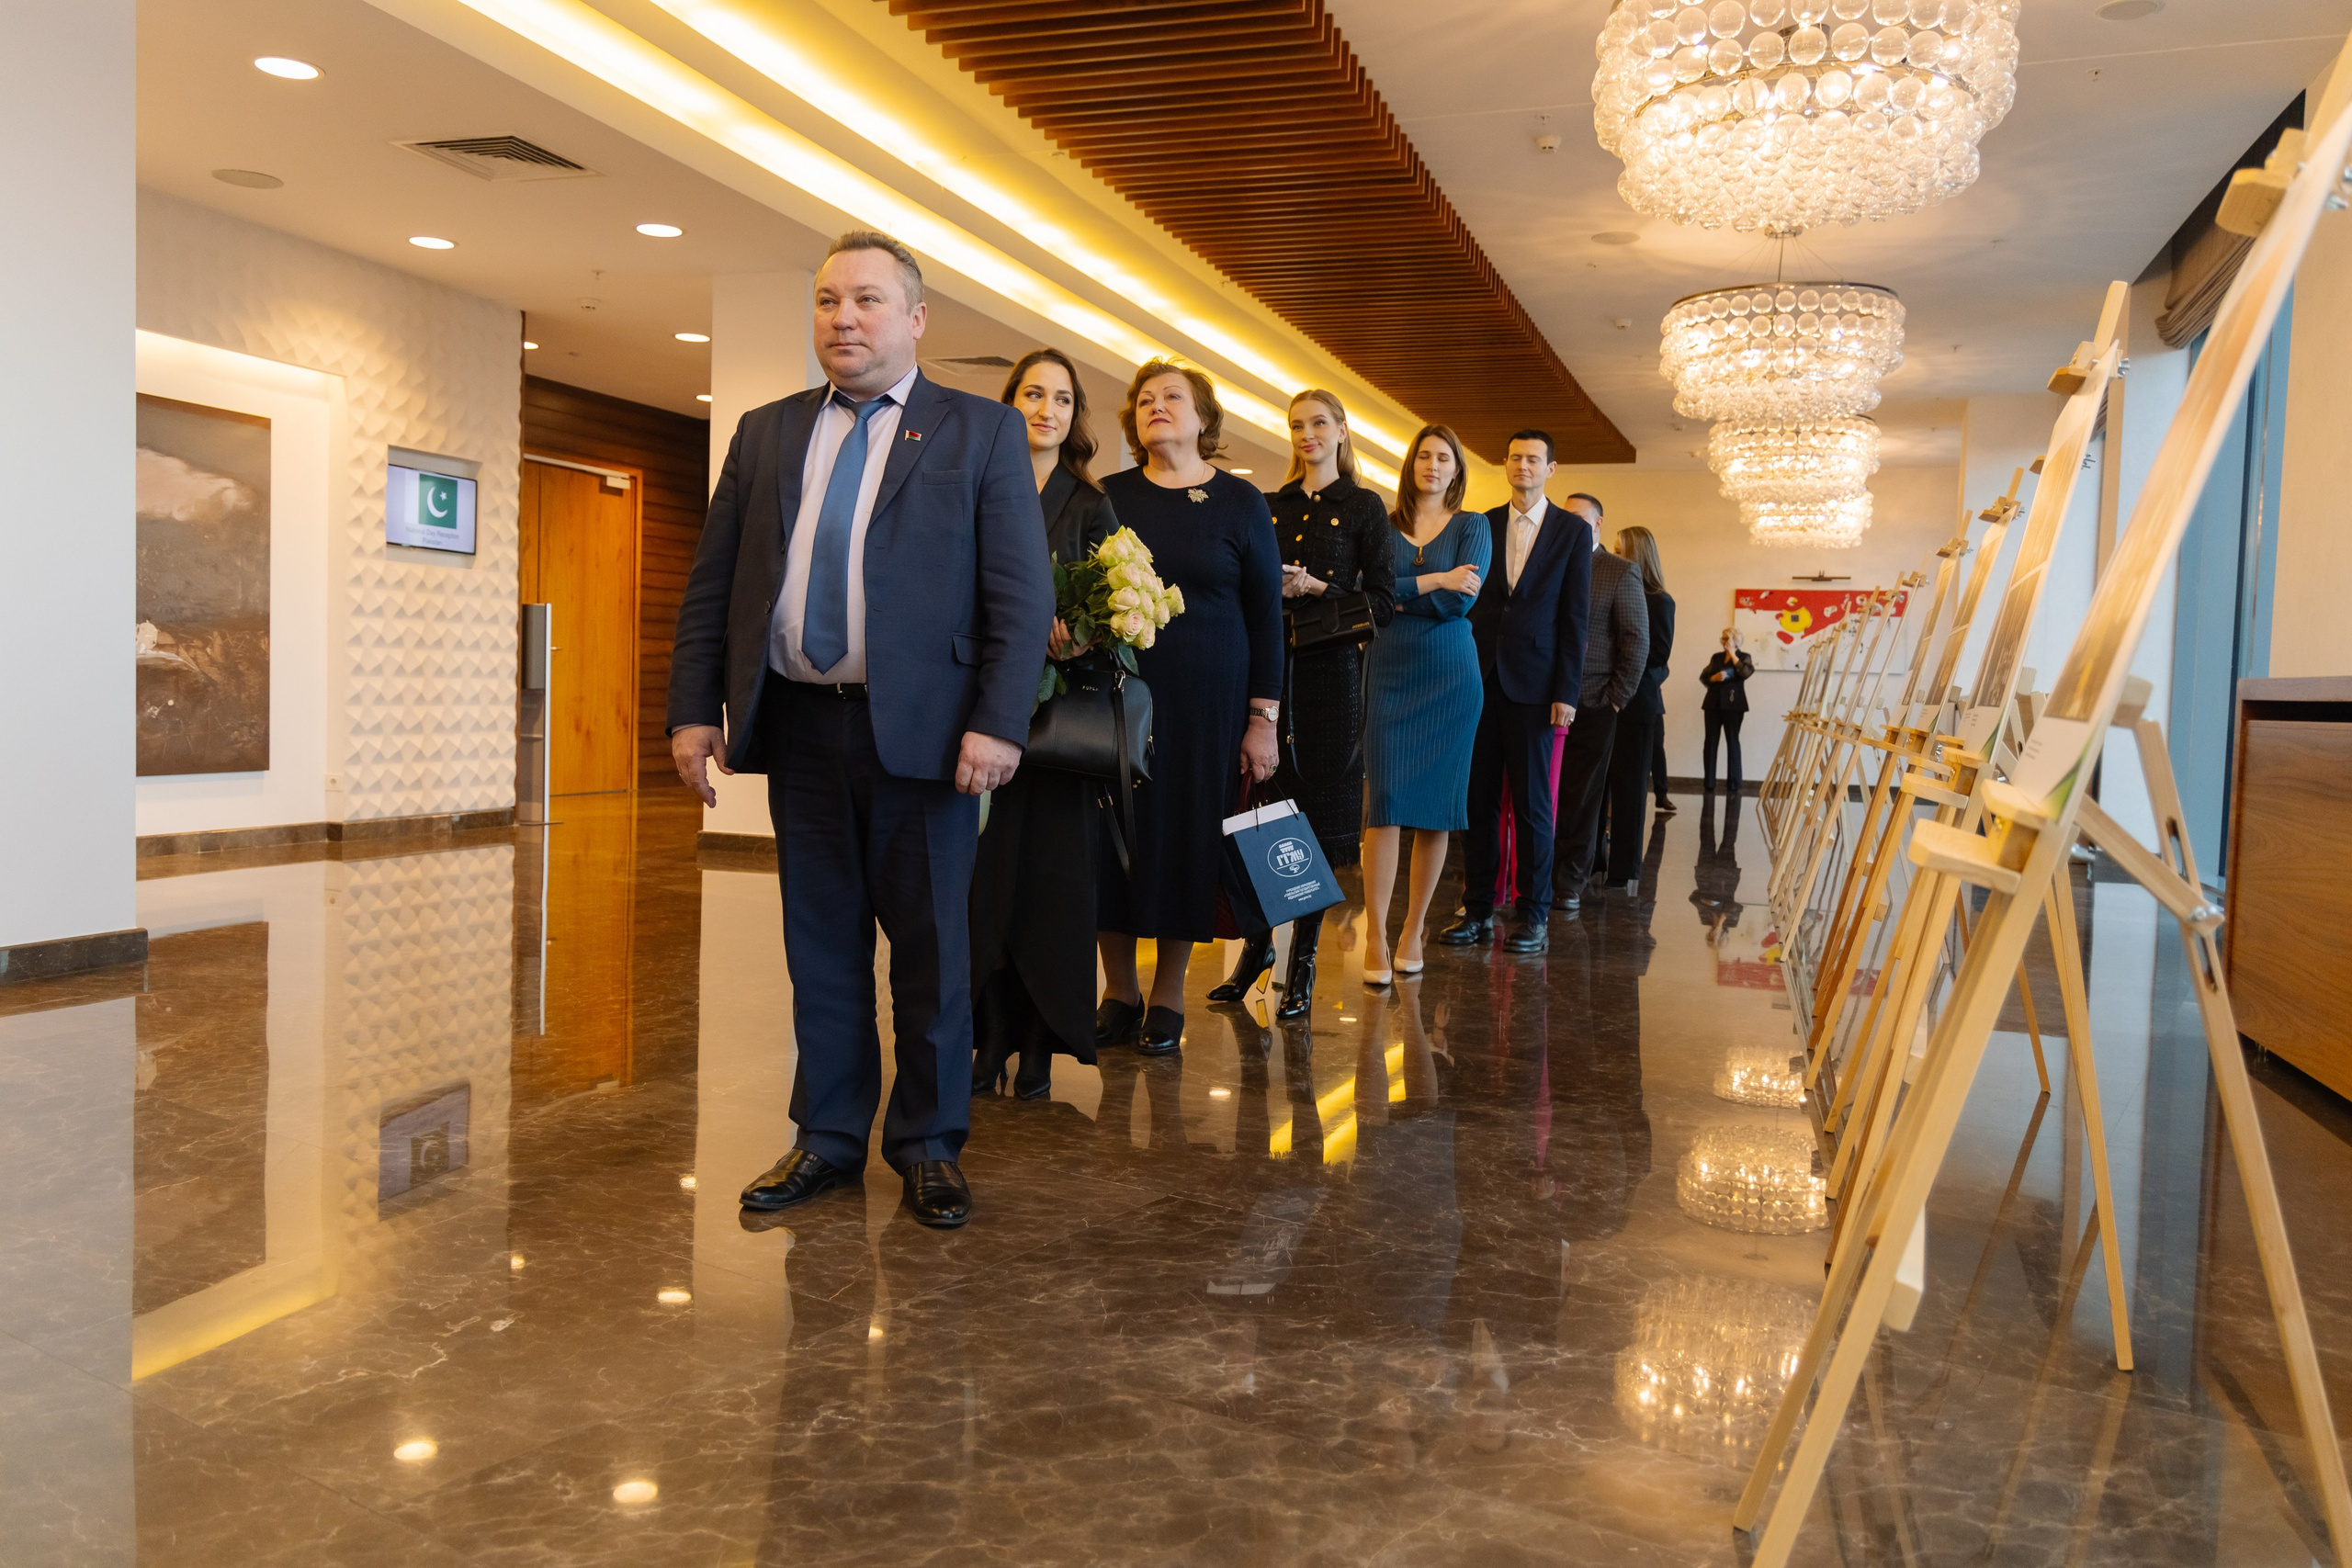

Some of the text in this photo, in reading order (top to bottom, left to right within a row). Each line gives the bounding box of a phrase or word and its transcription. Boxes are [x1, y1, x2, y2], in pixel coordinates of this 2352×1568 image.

[406, 526, 425, 535] National
[436, 531, 459, 539] Reception
[423, 537, 442, 546] Pakistan
